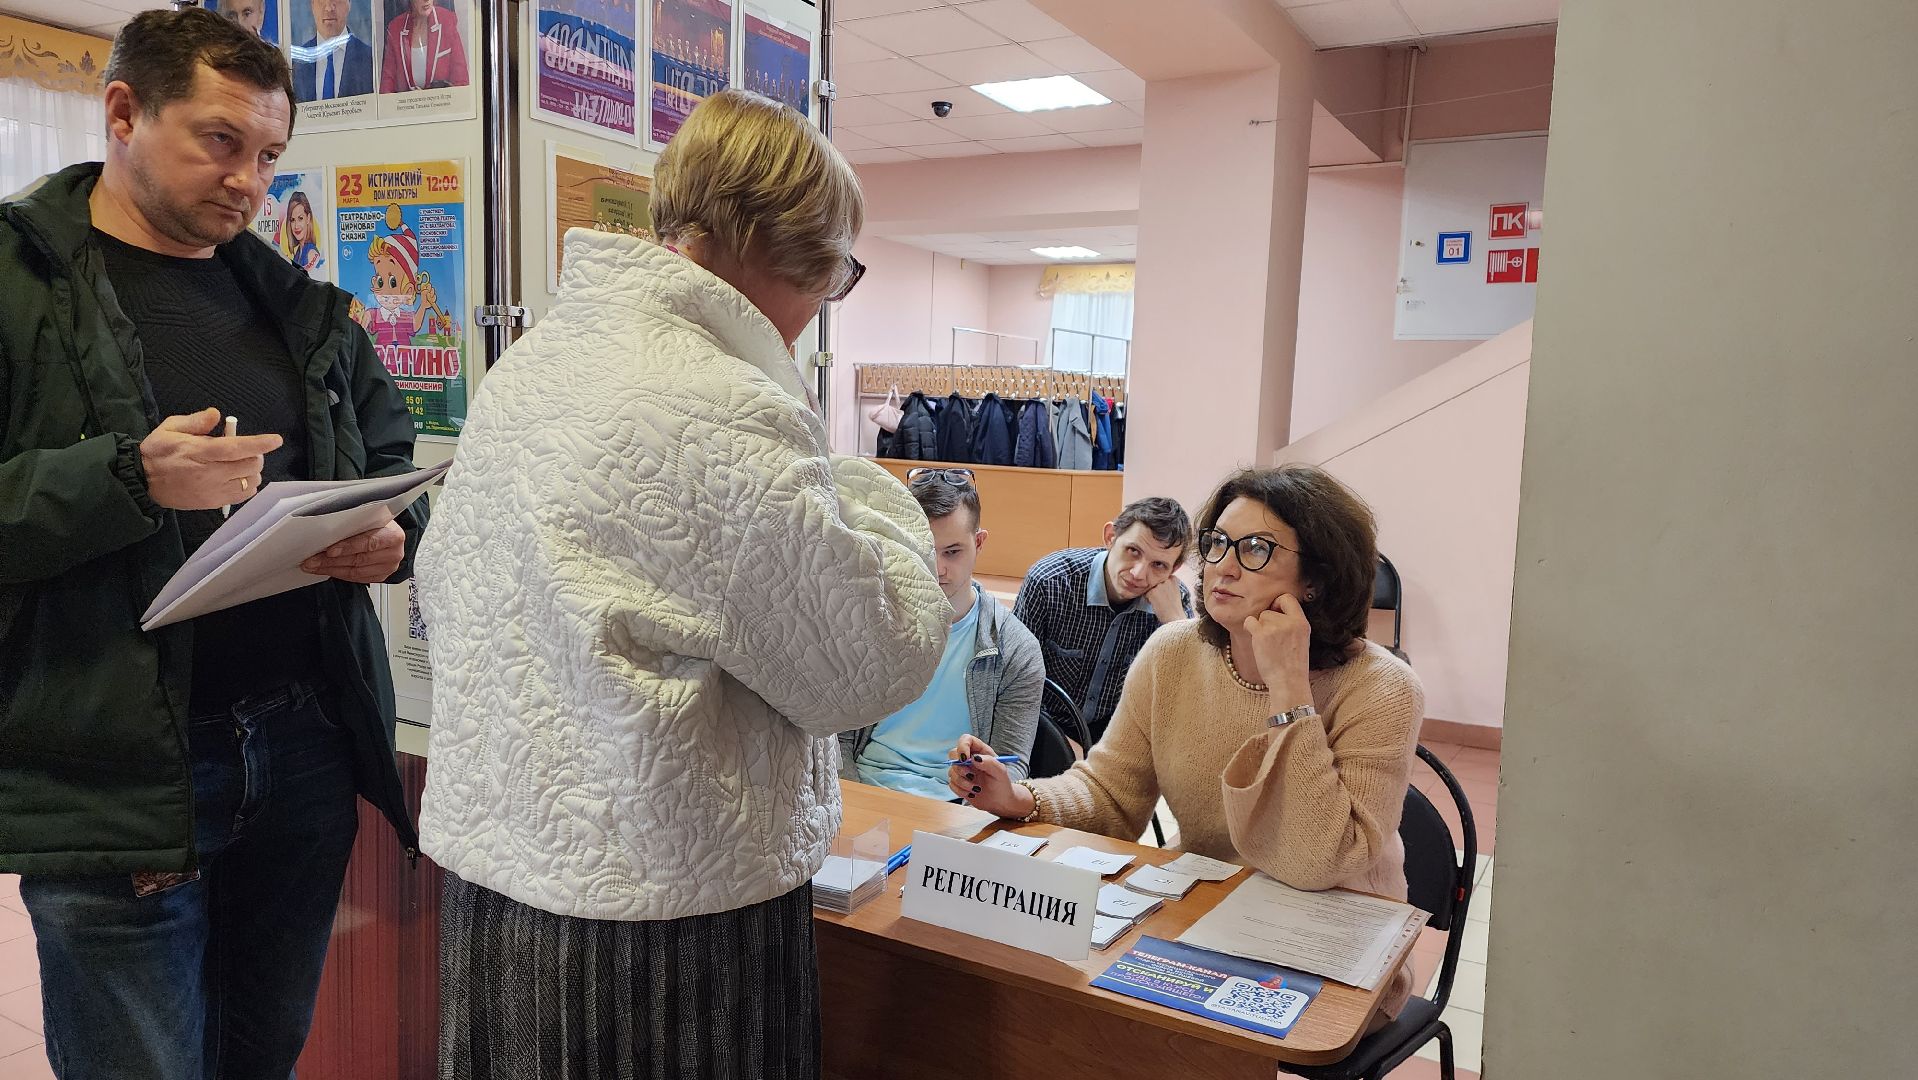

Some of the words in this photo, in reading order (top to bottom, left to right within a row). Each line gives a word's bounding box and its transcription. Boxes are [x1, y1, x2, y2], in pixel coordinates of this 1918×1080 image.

[339, 174, 363, 197] 23
[368, 168, 422, 188] ИСТРИНСКИЙ
[427, 175, 459, 192] 12:00
[373, 191, 386, 201] ДОМ
[387, 188, 418, 200] КУЛЬТУРЫ
[263, 198, 273, 217] 15
[340, 212, 384, 221] ТЕАТРАЛЬНО-
[1492, 212, 1524, 232] ПК
[258, 219, 280, 233] АПРЕЛЯ
[341, 222, 375, 231] ЦИРКОВАЯ
[341, 232, 366, 241] СКАЗКА
[343, 248, 352, 257] 0+
[1448, 247, 1460, 256] 01
[415, 396, 423, 405] 01
[415, 407, 424, 416] 42
[921, 865, 1078, 926] РЕГИСТРАЦИЯ
[1132, 949, 1228, 979] ТЕЛЕГРАМ-КАНАЛ
[1110, 970, 1205, 1000] ПРОИСХОДЯЩЕГО!
[1116, 964, 1201, 990] ОТСКАНИРУЙ
[1203, 986, 1214, 994] И
[1125, 972, 1152, 982] БУДЬ
[1162, 980, 1196, 994] КУРСЕ
